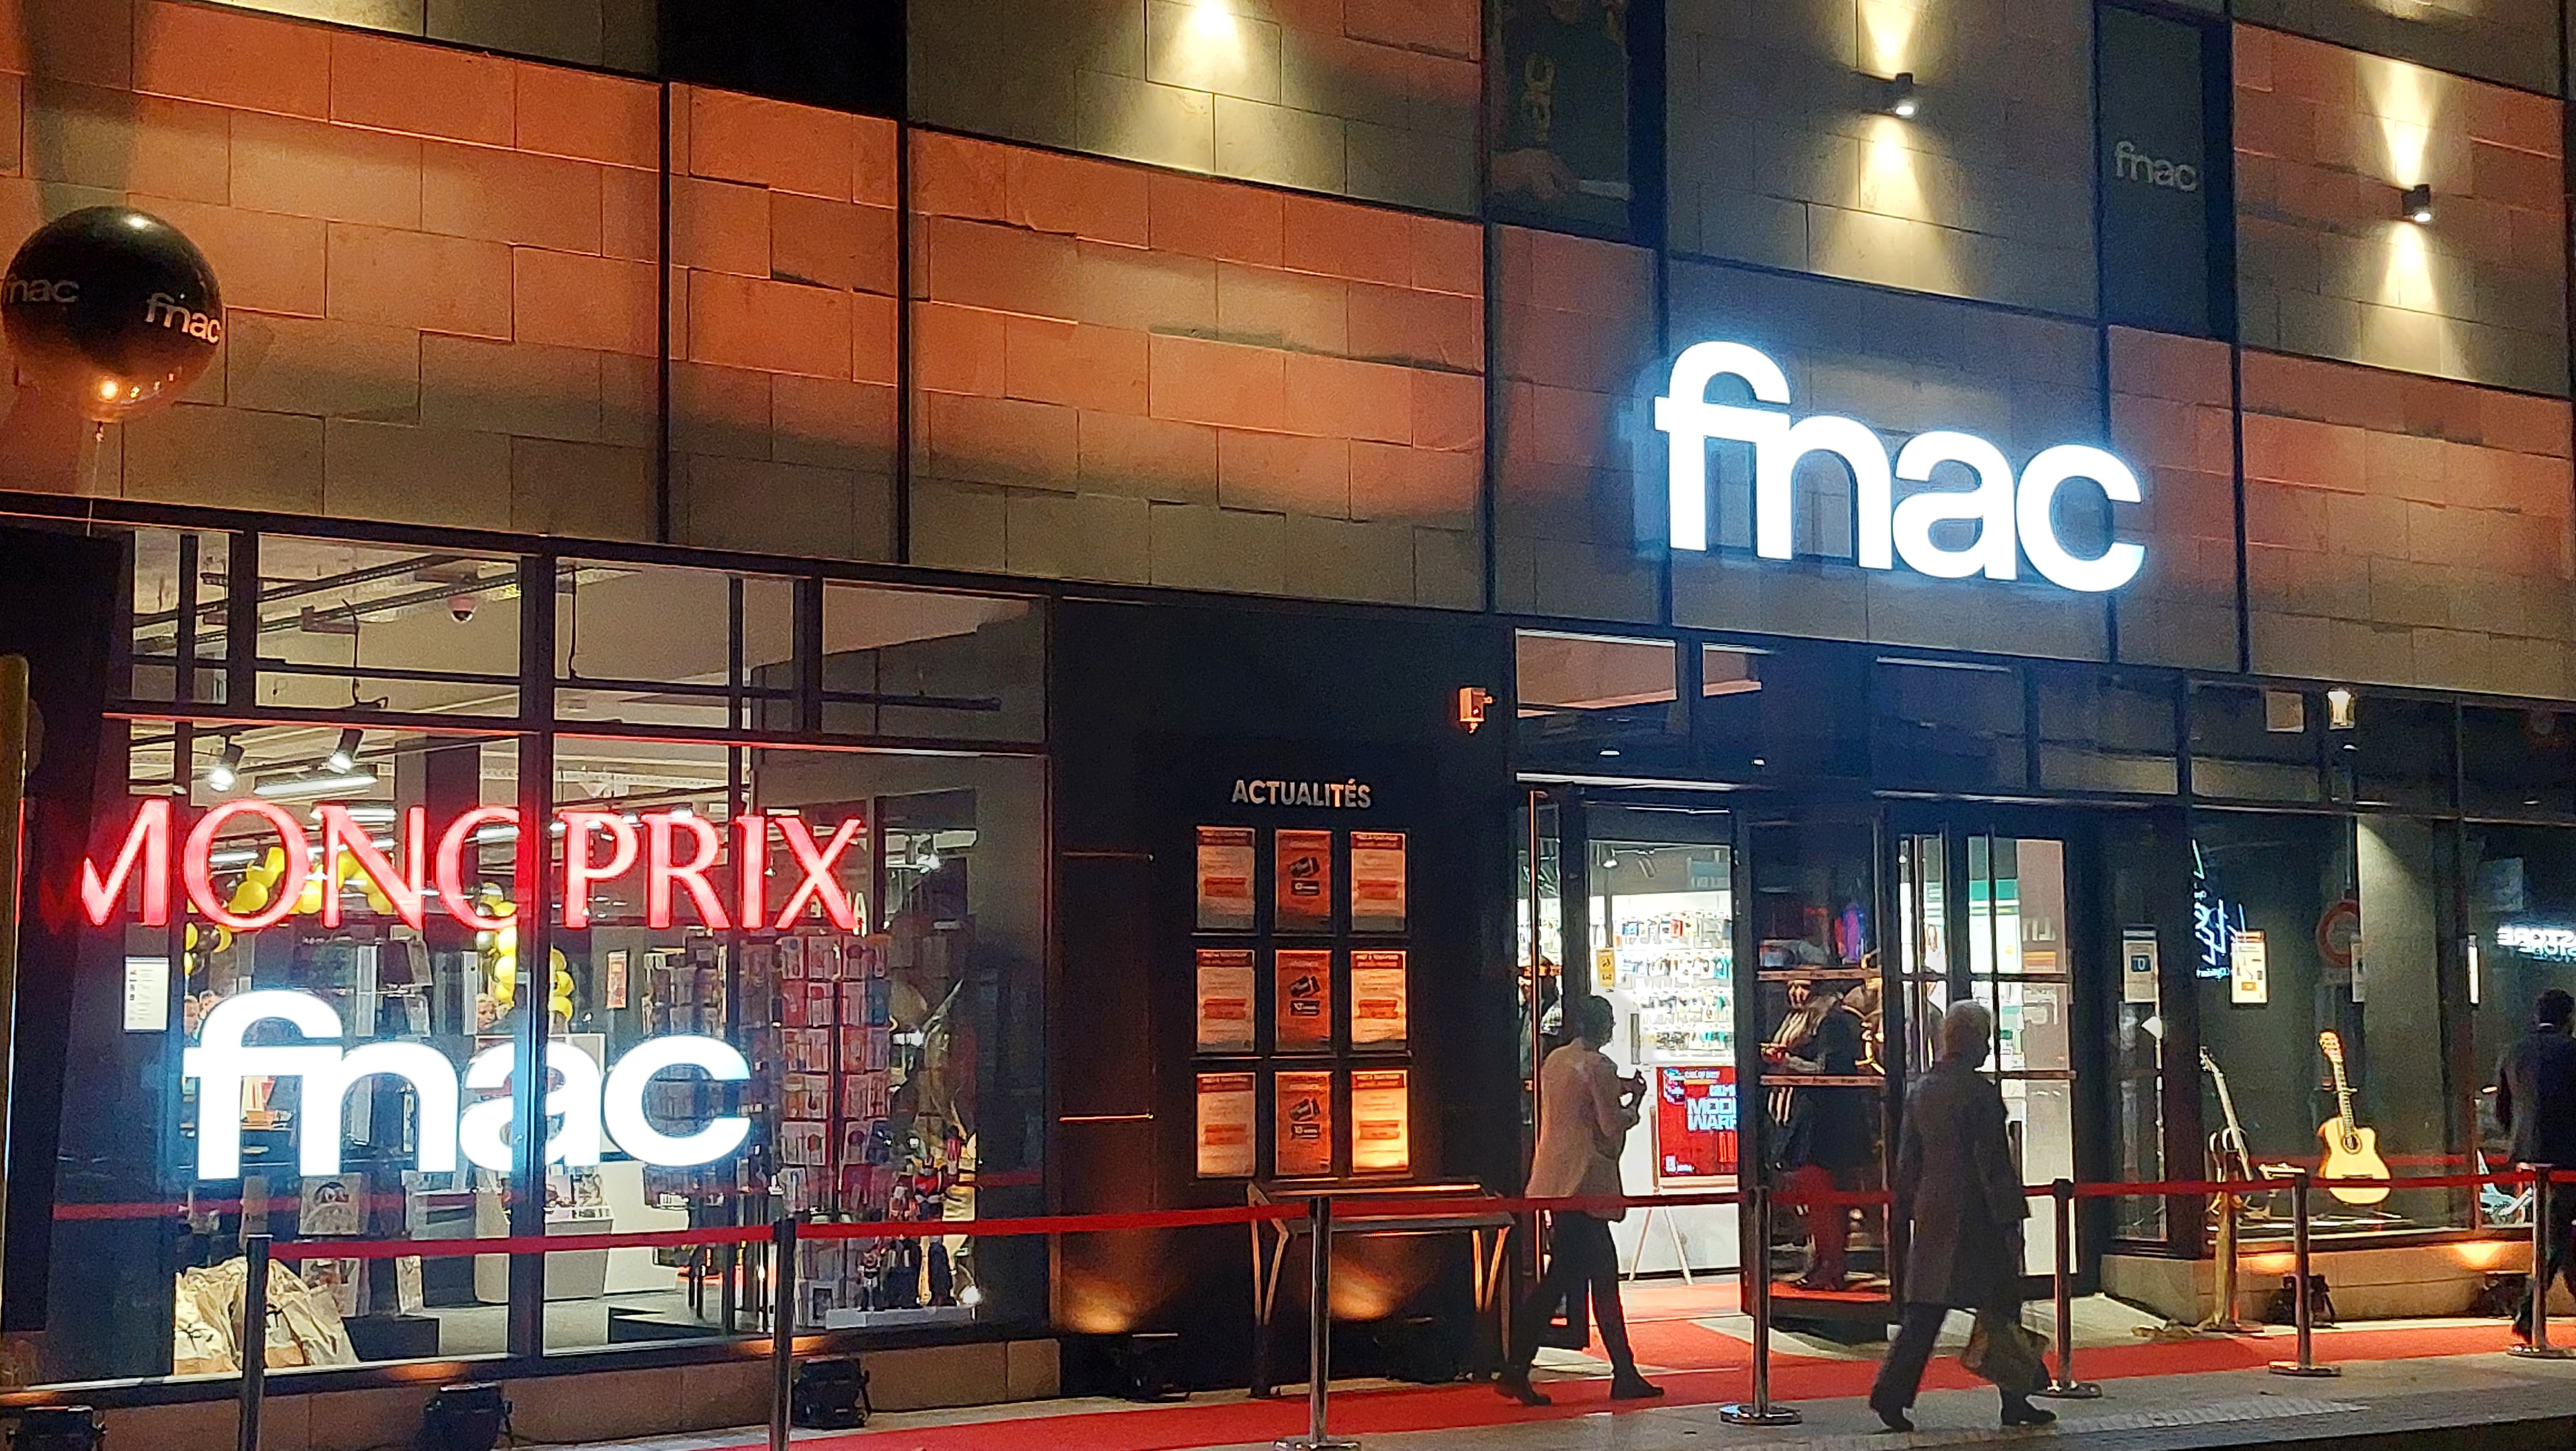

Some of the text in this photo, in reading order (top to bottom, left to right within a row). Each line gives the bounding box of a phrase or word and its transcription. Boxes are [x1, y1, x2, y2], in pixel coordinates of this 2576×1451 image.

[2115, 141, 2197, 192] fnac
[144, 293, 221, 344] fnac
[1655, 342, 2144, 592] fnac
[1232, 778, 1371, 808] ACTUALITÉS
[184, 990, 750, 1179] fnac
